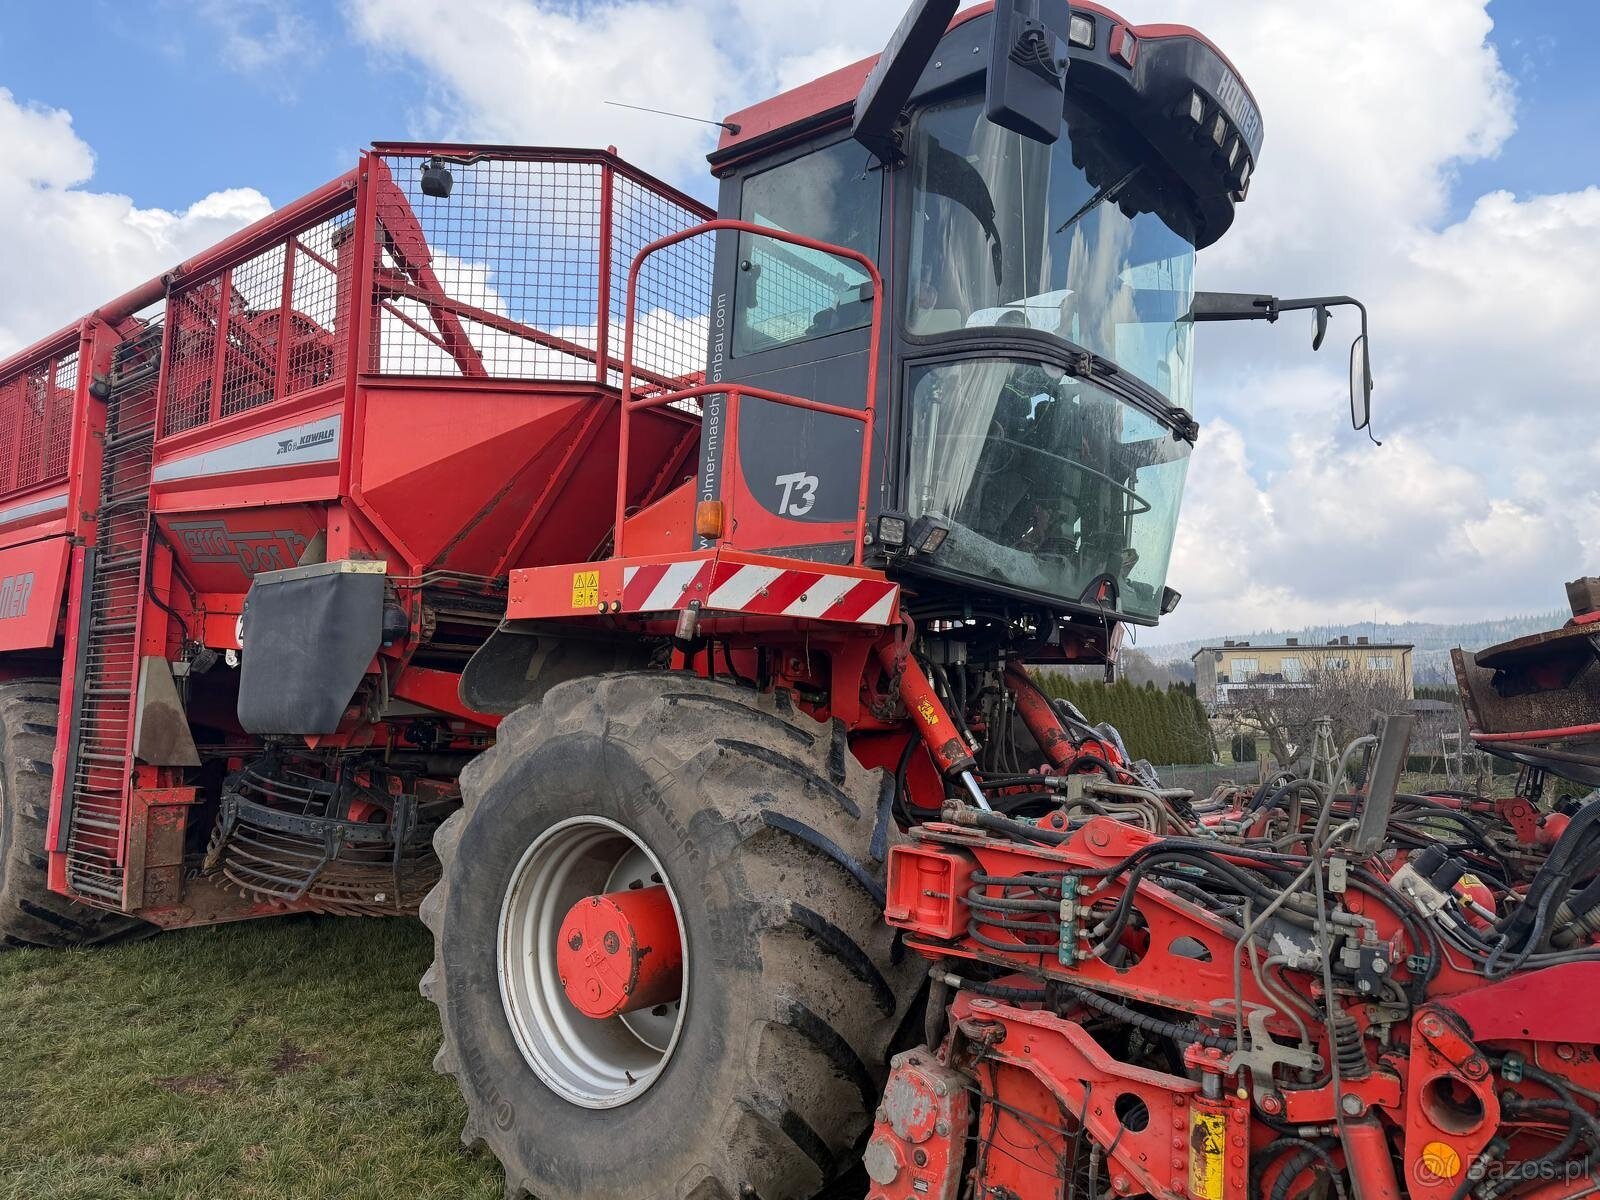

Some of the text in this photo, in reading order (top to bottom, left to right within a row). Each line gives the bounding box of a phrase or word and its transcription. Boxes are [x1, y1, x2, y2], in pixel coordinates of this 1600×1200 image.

[1216, 68, 1259, 142] HOLMER
[299, 429, 335, 445] KOWALA
[775, 471, 819, 516] T3
